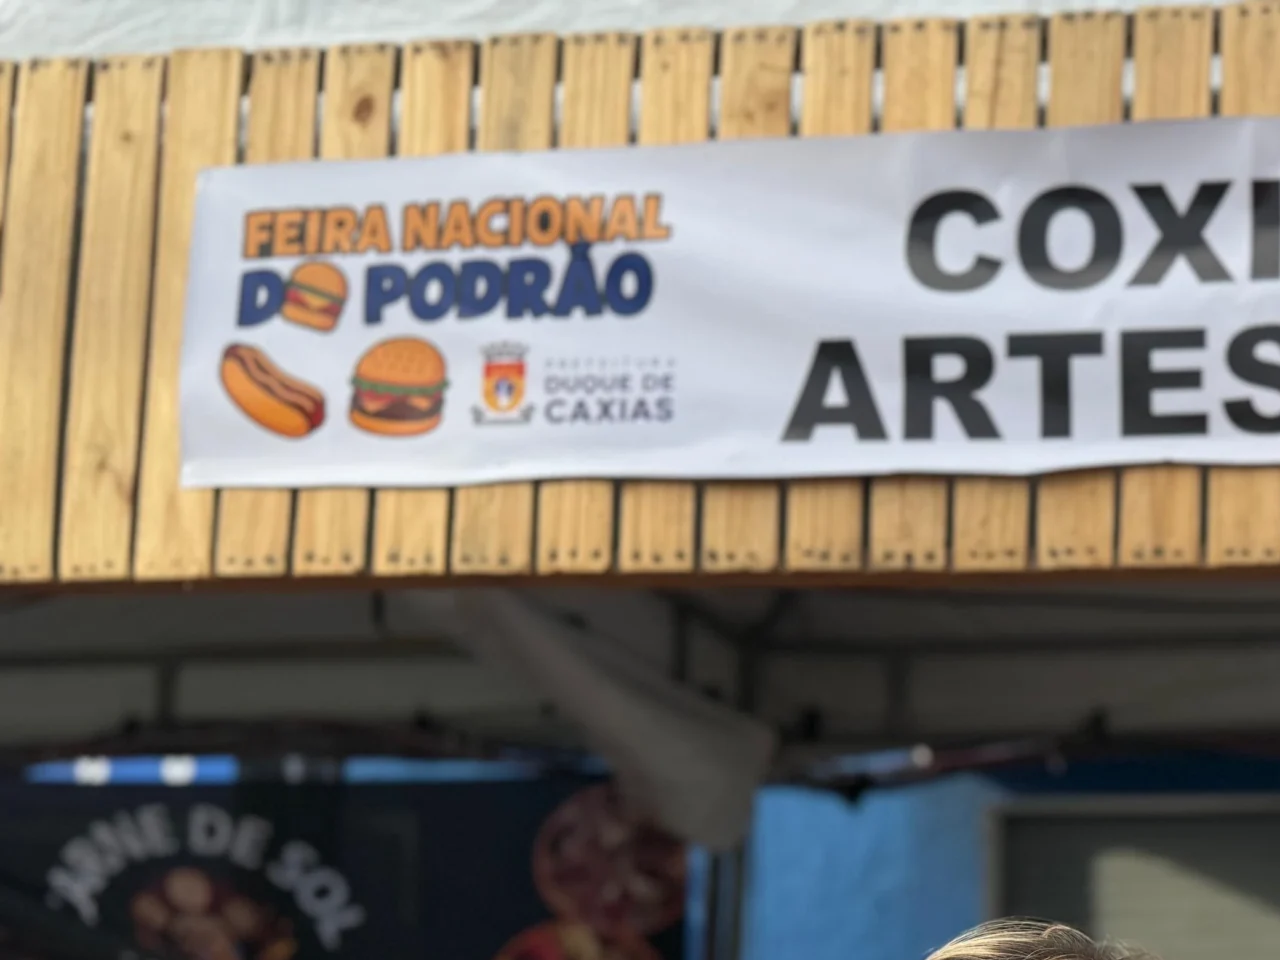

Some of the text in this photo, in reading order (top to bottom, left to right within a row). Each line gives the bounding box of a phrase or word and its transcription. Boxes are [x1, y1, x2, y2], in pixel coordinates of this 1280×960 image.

[243, 192, 671, 260] FEIRA NACIONAL
[364, 241, 655, 326] PODRÃO
[543, 396, 675, 425] CAXIAS
[544, 371, 677, 396] DUQUE DE
[187, 801, 275, 872] DE
